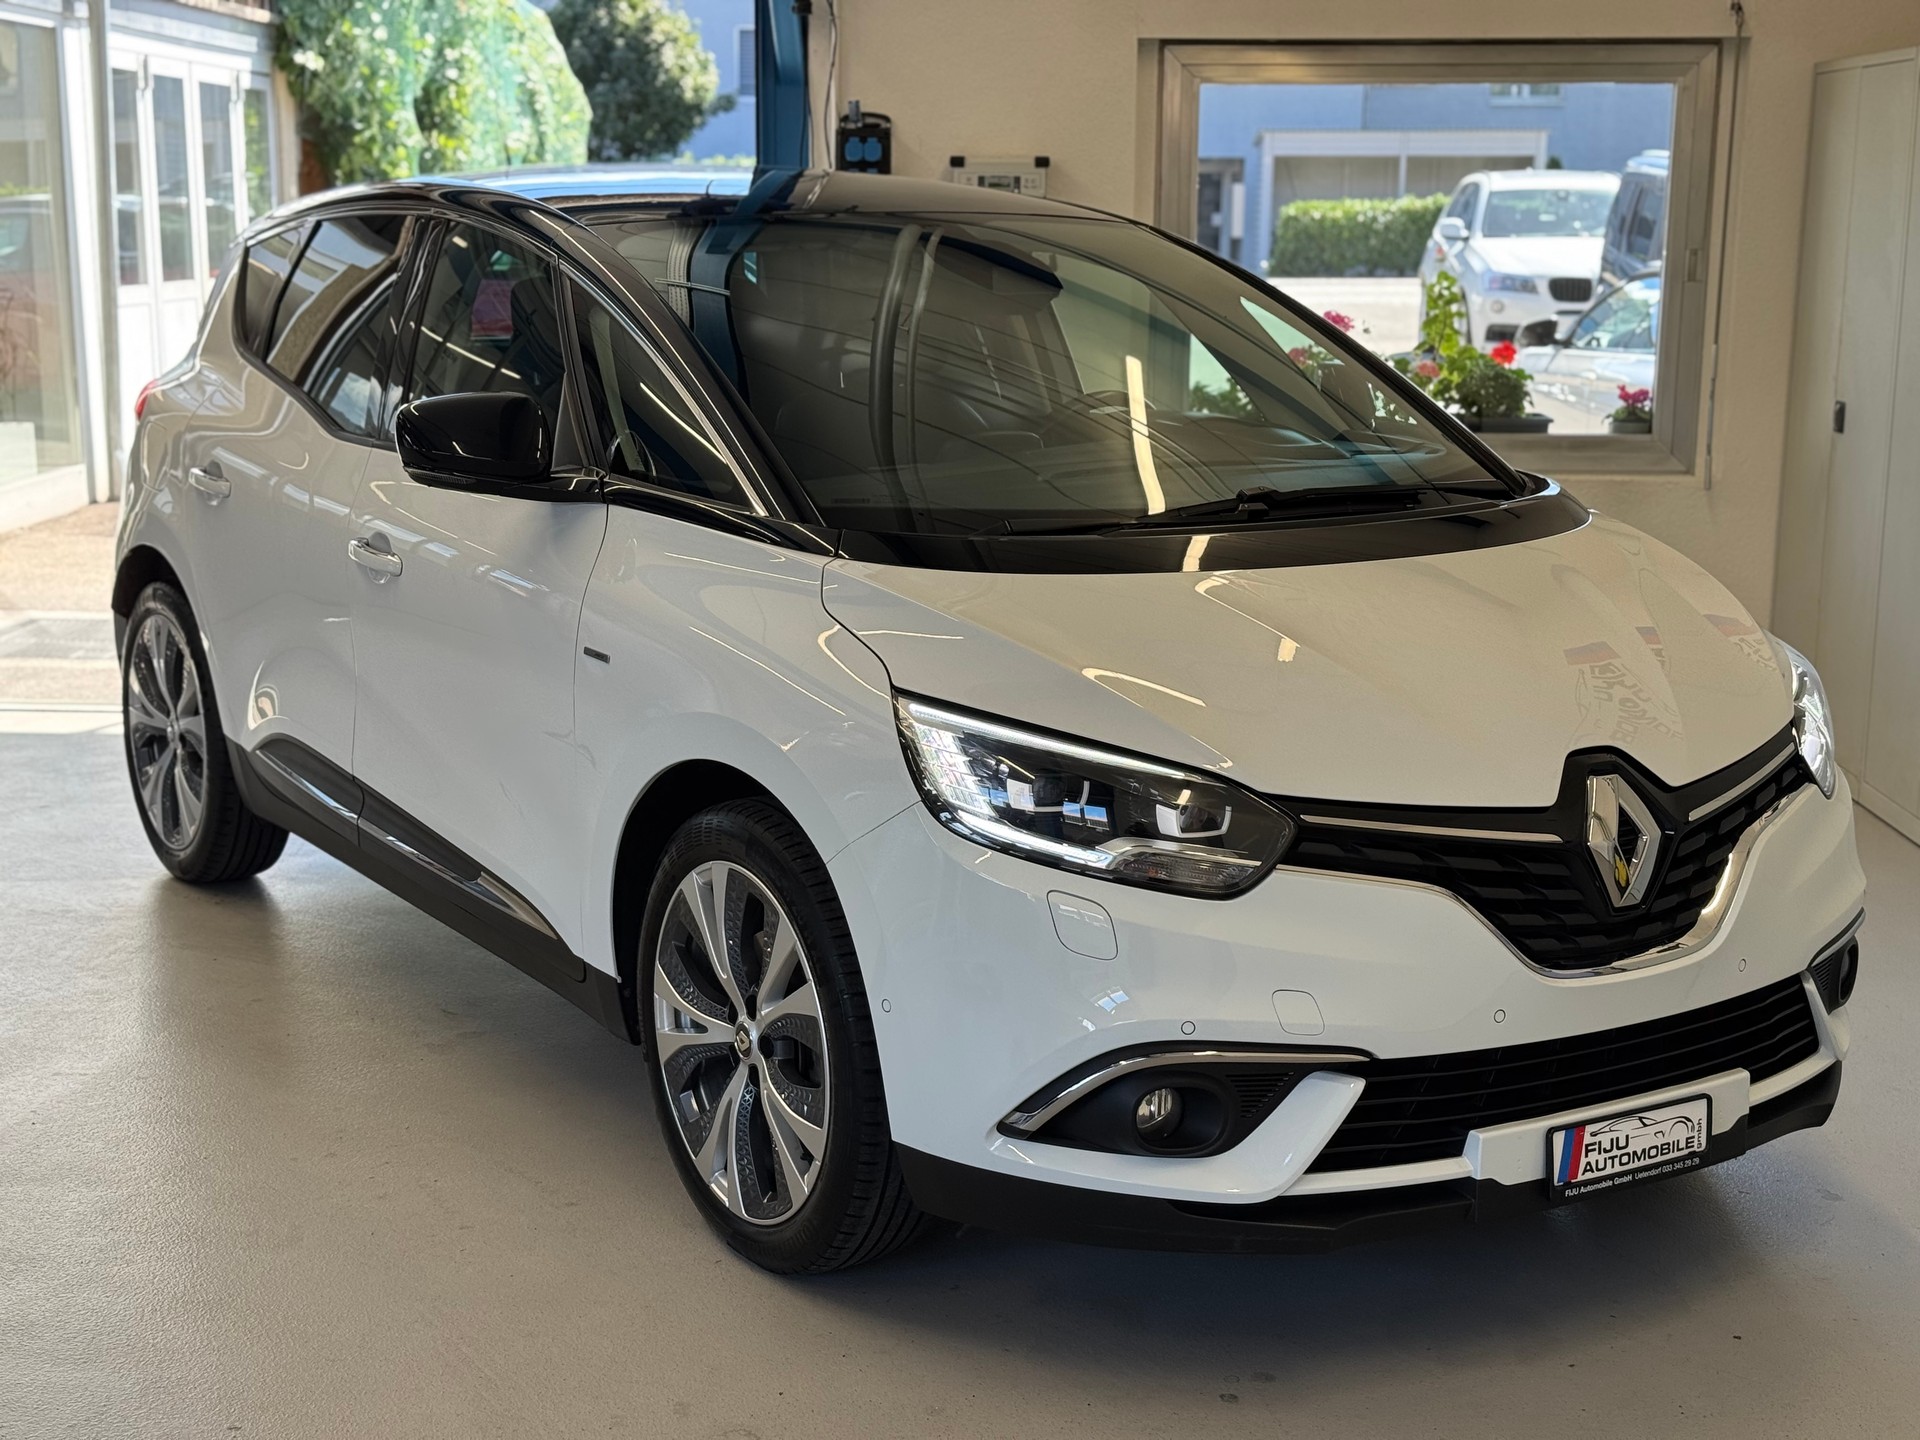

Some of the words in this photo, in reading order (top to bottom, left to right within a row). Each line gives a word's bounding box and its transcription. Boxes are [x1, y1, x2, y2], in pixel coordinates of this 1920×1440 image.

[1581, 1135, 1696, 1176] AUTOMOBILE
[1584, 1134, 1630, 1158] FIJU
[1565, 1187, 1579, 1197] FIJU
[1580, 1180, 1613, 1193] Automobile
[1614, 1174, 1633, 1184] GmbH
[1635, 1167, 1662, 1179] Uetendorf
[1662, 1164, 1672, 1173] 033
[1673, 1161, 1684, 1170] 345
[1684, 1159, 1692, 1168] 29
[1692, 1157, 1700, 1166] 29
